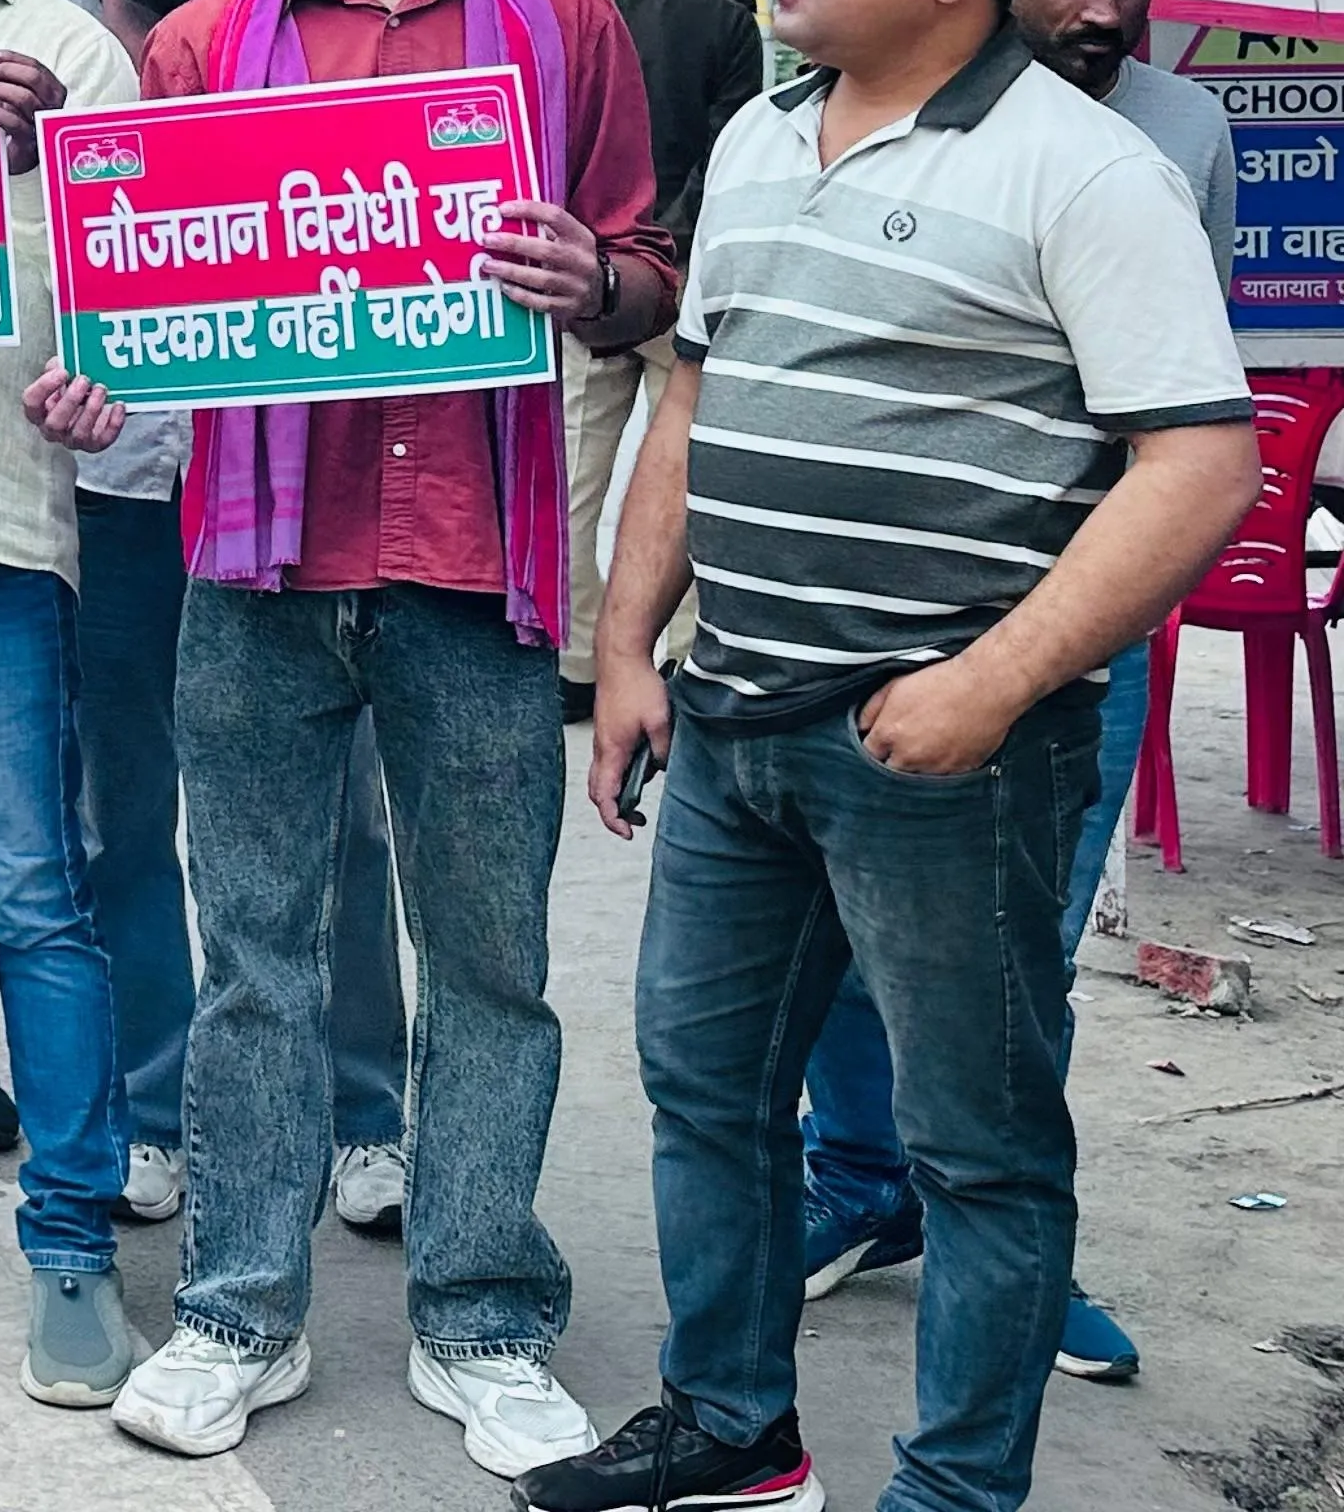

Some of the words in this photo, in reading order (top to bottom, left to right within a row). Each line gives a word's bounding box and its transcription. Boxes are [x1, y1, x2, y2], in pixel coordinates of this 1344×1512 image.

[1236, 136, 1339, 183] आगे
[278, 159, 421, 259] विरोधी
[427, 177, 504, 246] यह
[99, 298, 258, 370] सरकार
[265, 265, 362, 361] नहीं
[366, 252, 507, 350] चलेगी
[1240, 278, 1330, 300] यातायात
